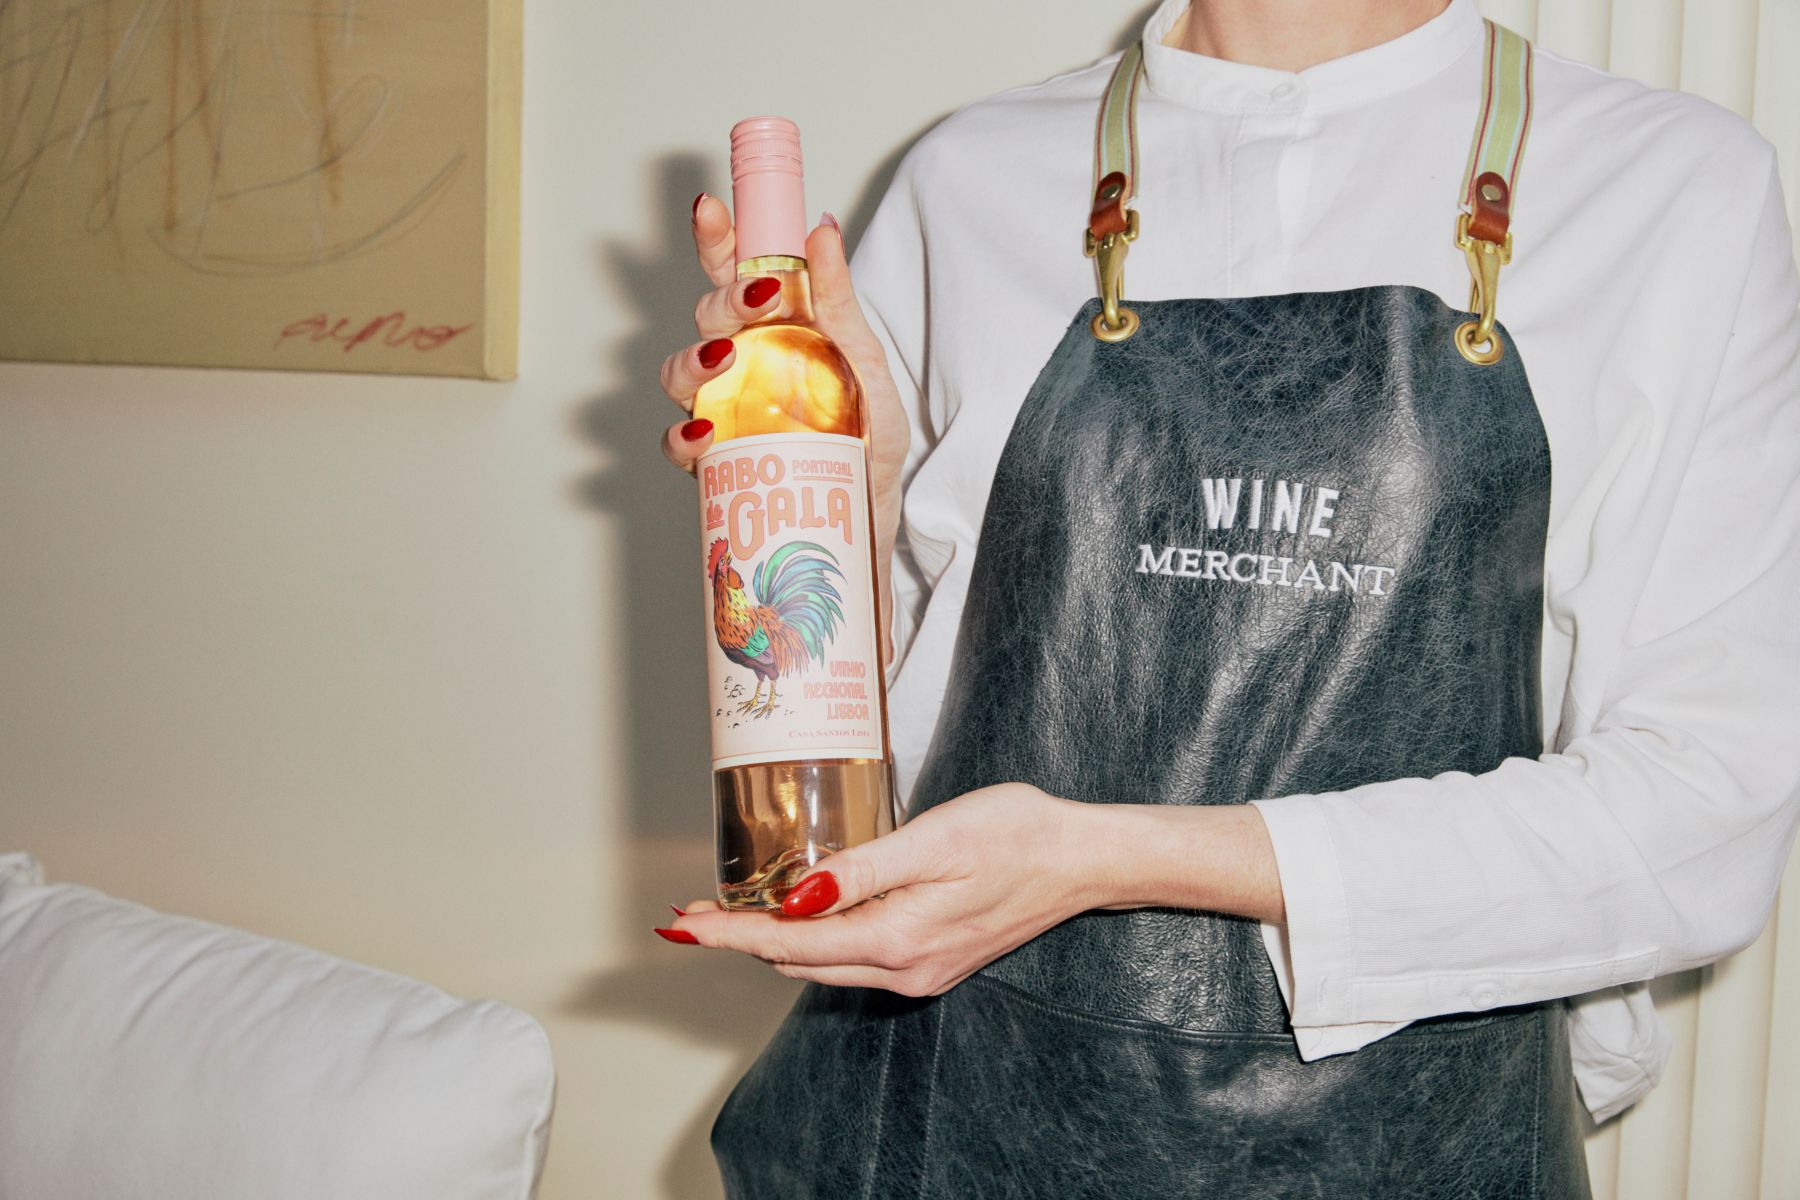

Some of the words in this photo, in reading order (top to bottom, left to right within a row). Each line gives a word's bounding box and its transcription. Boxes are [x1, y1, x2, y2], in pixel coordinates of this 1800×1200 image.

[704, 453, 786, 499] RABO
[792, 459, 854, 477] PORTUGAL
[706, 500, 724, 523] de
[728, 486, 853, 561] GALA
[1201, 478, 1340, 538] WINE
[1135, 544, 1396, 596] MERCHANT
[803, 681, 868, 700] REGIONAL
[830, 660, 866, 678] VINHO
[827, 703, 869, 720] LISBOA
